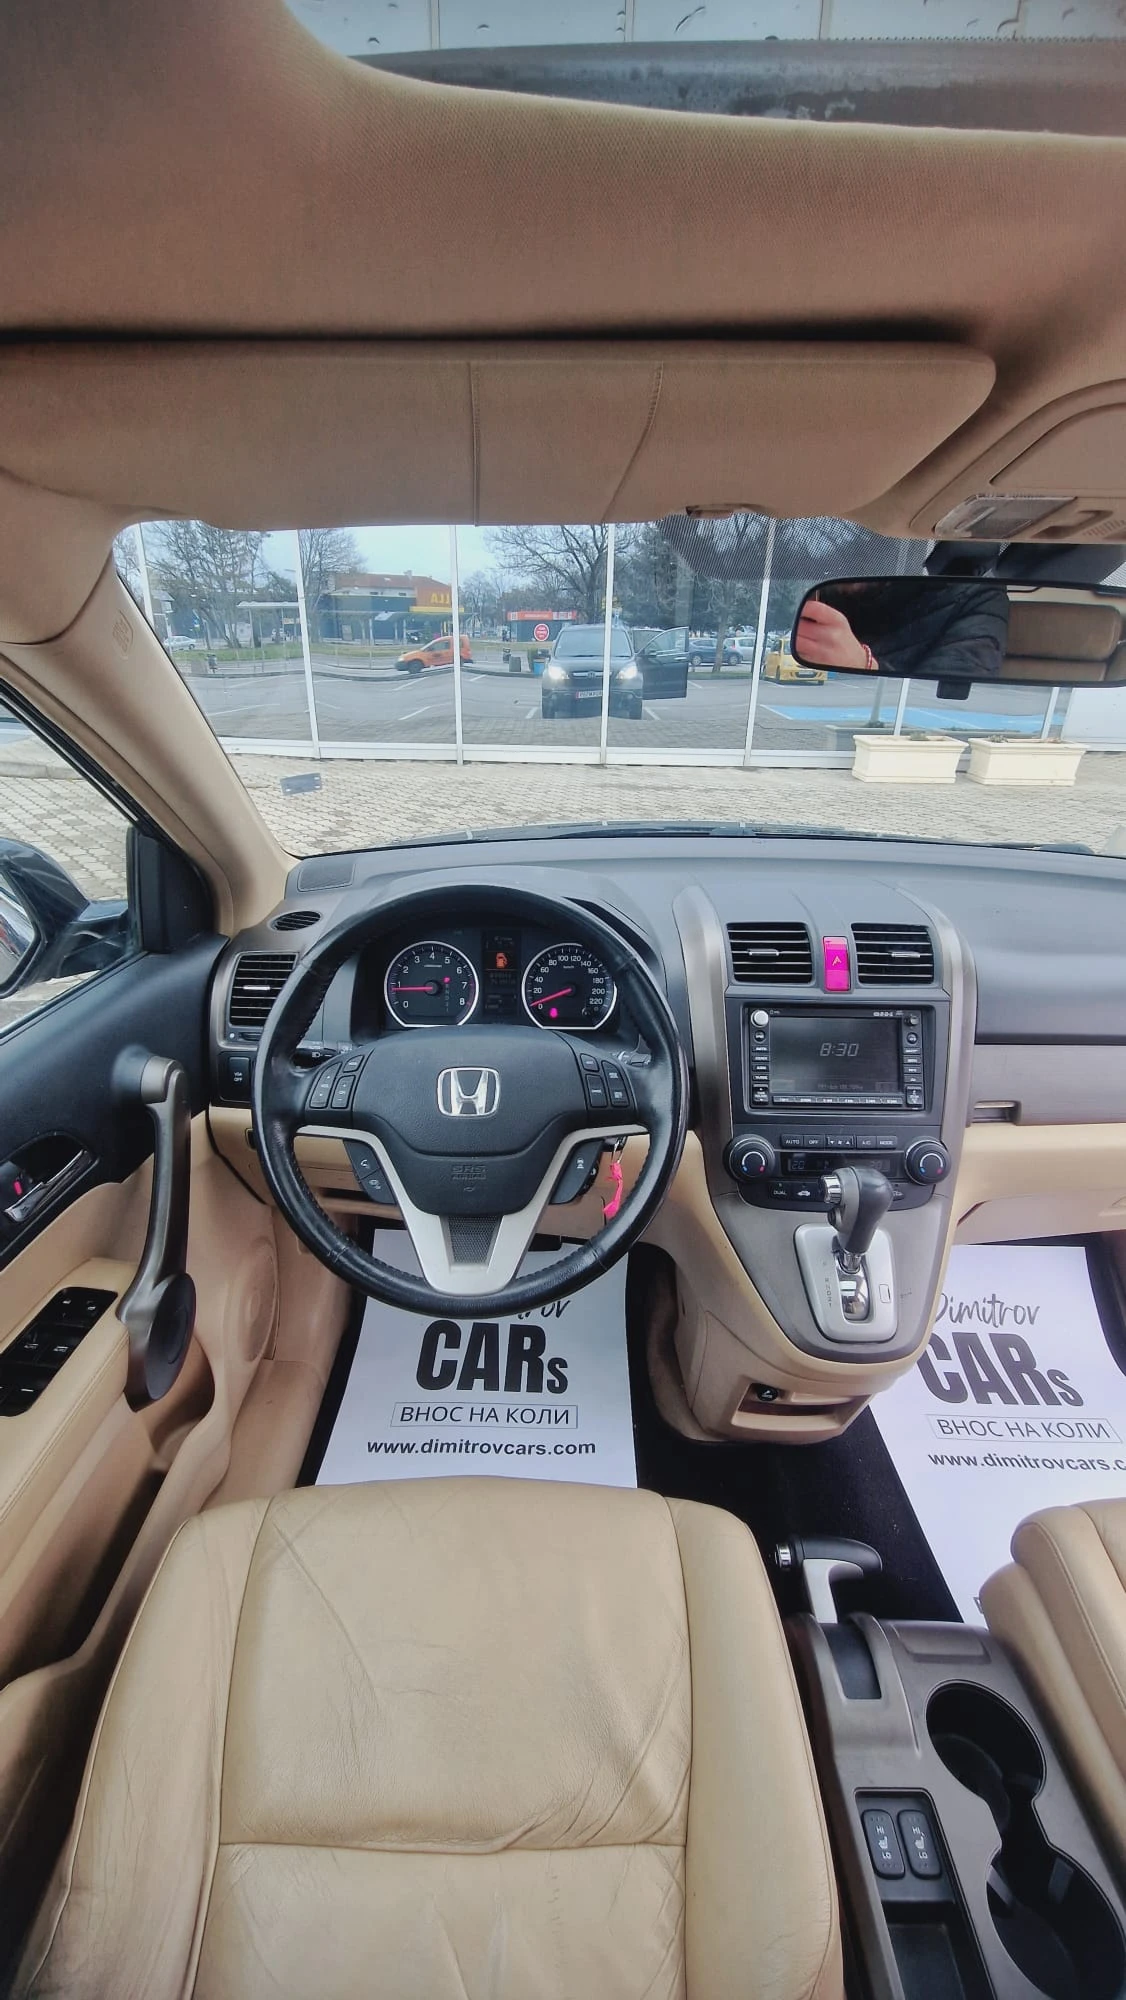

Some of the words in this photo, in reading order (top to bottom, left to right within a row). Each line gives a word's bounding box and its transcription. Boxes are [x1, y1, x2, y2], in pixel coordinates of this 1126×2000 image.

[429, 952, 435, 960] 4
[820, 1042, 859, 1057] 8:30
[791, 1160, 805, 1170] 20
[416, 1318, 568, 1394] CARs
[917, 1332, 1084, 1407] CARs
[400, 1406, 464, 1422] ВНОС
[469, 1407, 499, 1423] НА
[506, 1408, 569, 1425] КОЛИ
[937, 1419, 1005, 1438] ВНОС
[1008, 1420, 1042, 1438] НА
[1043, 1421, 1111, 1439] КОЛИ
[367, 1438, 596, 1456] www.dimitrovcars.com
[876, 1825, 885, 1834] HI
[912, 1826, 921, 1834] HI
